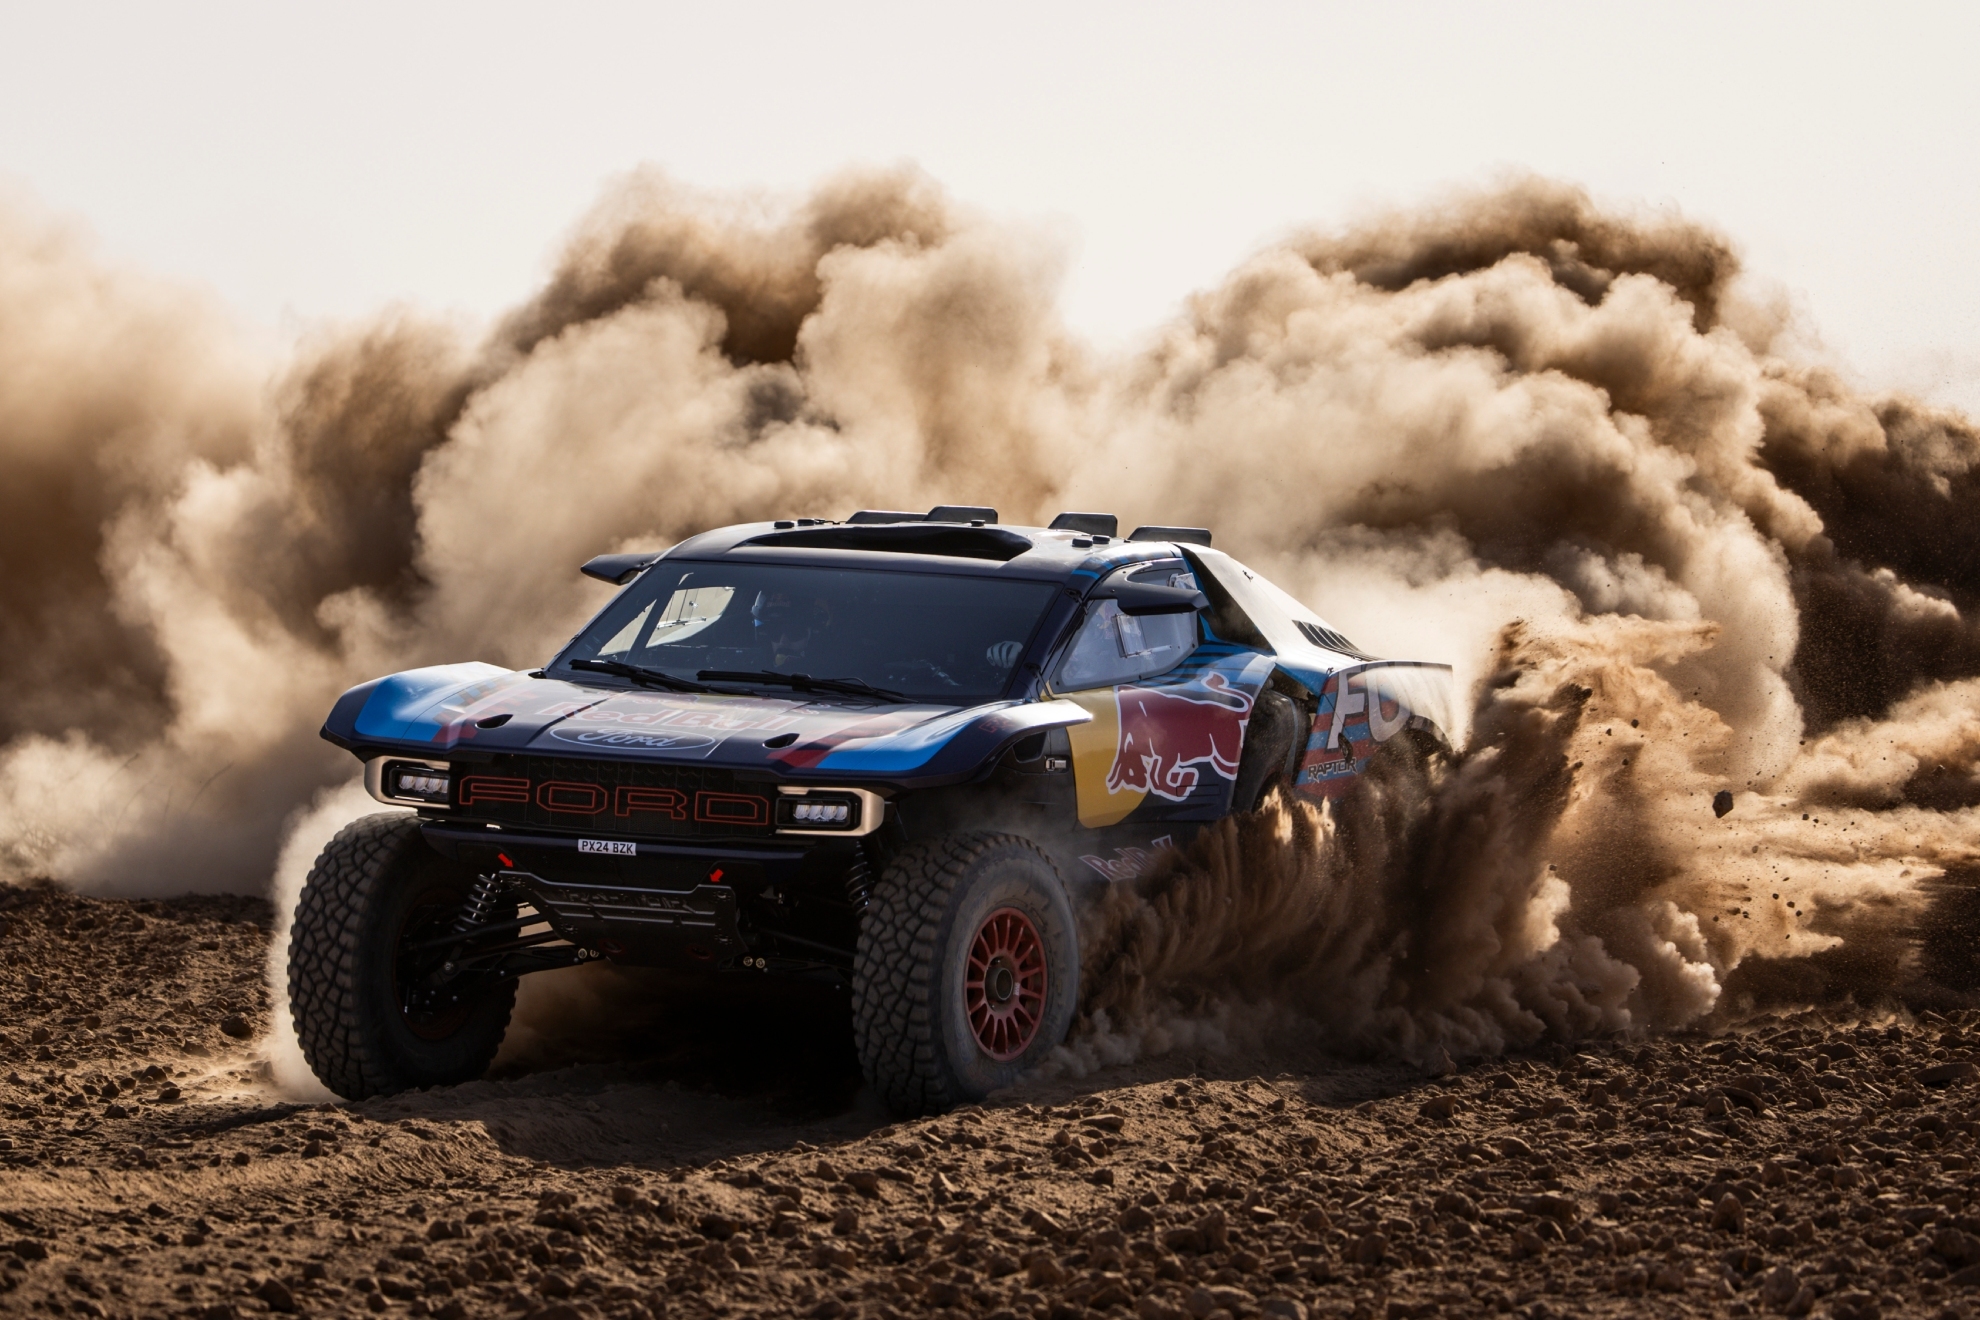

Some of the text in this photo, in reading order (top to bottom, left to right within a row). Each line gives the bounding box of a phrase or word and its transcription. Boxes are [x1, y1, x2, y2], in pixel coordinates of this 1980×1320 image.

[577, 728, 687, 747] Ford
[1308, 757, 1358, 783] RAPTOR
[459, 775, 770, 825] FORD
[582, 840, 633, 854] PX24 BZK
